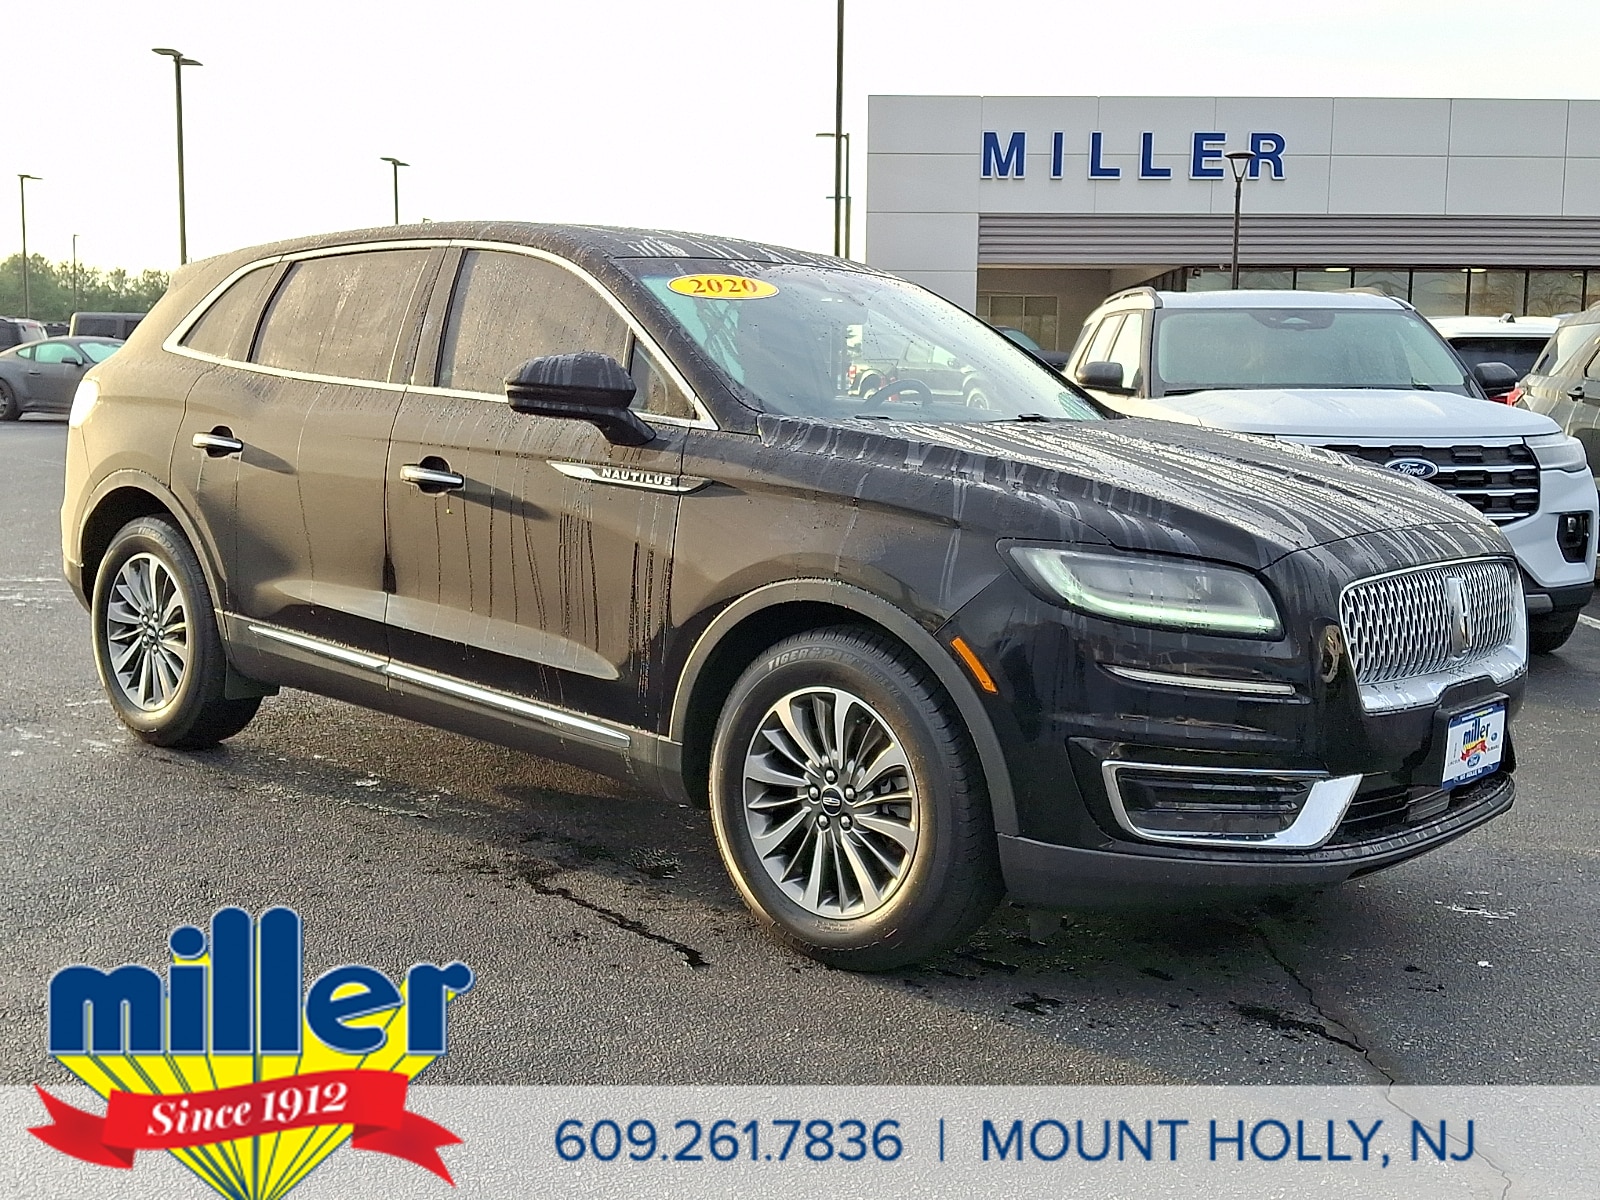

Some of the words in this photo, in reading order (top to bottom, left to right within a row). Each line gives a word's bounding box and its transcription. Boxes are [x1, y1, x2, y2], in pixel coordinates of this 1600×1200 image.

[980, 130, 1286, 180] MILLER
[689, 279, 758, 293] 2020
[601, 468, 673, 486] NAUTILUS
[1398, 462, 1426, 475] Ford
[1463, 717, 1491, 745] miller
